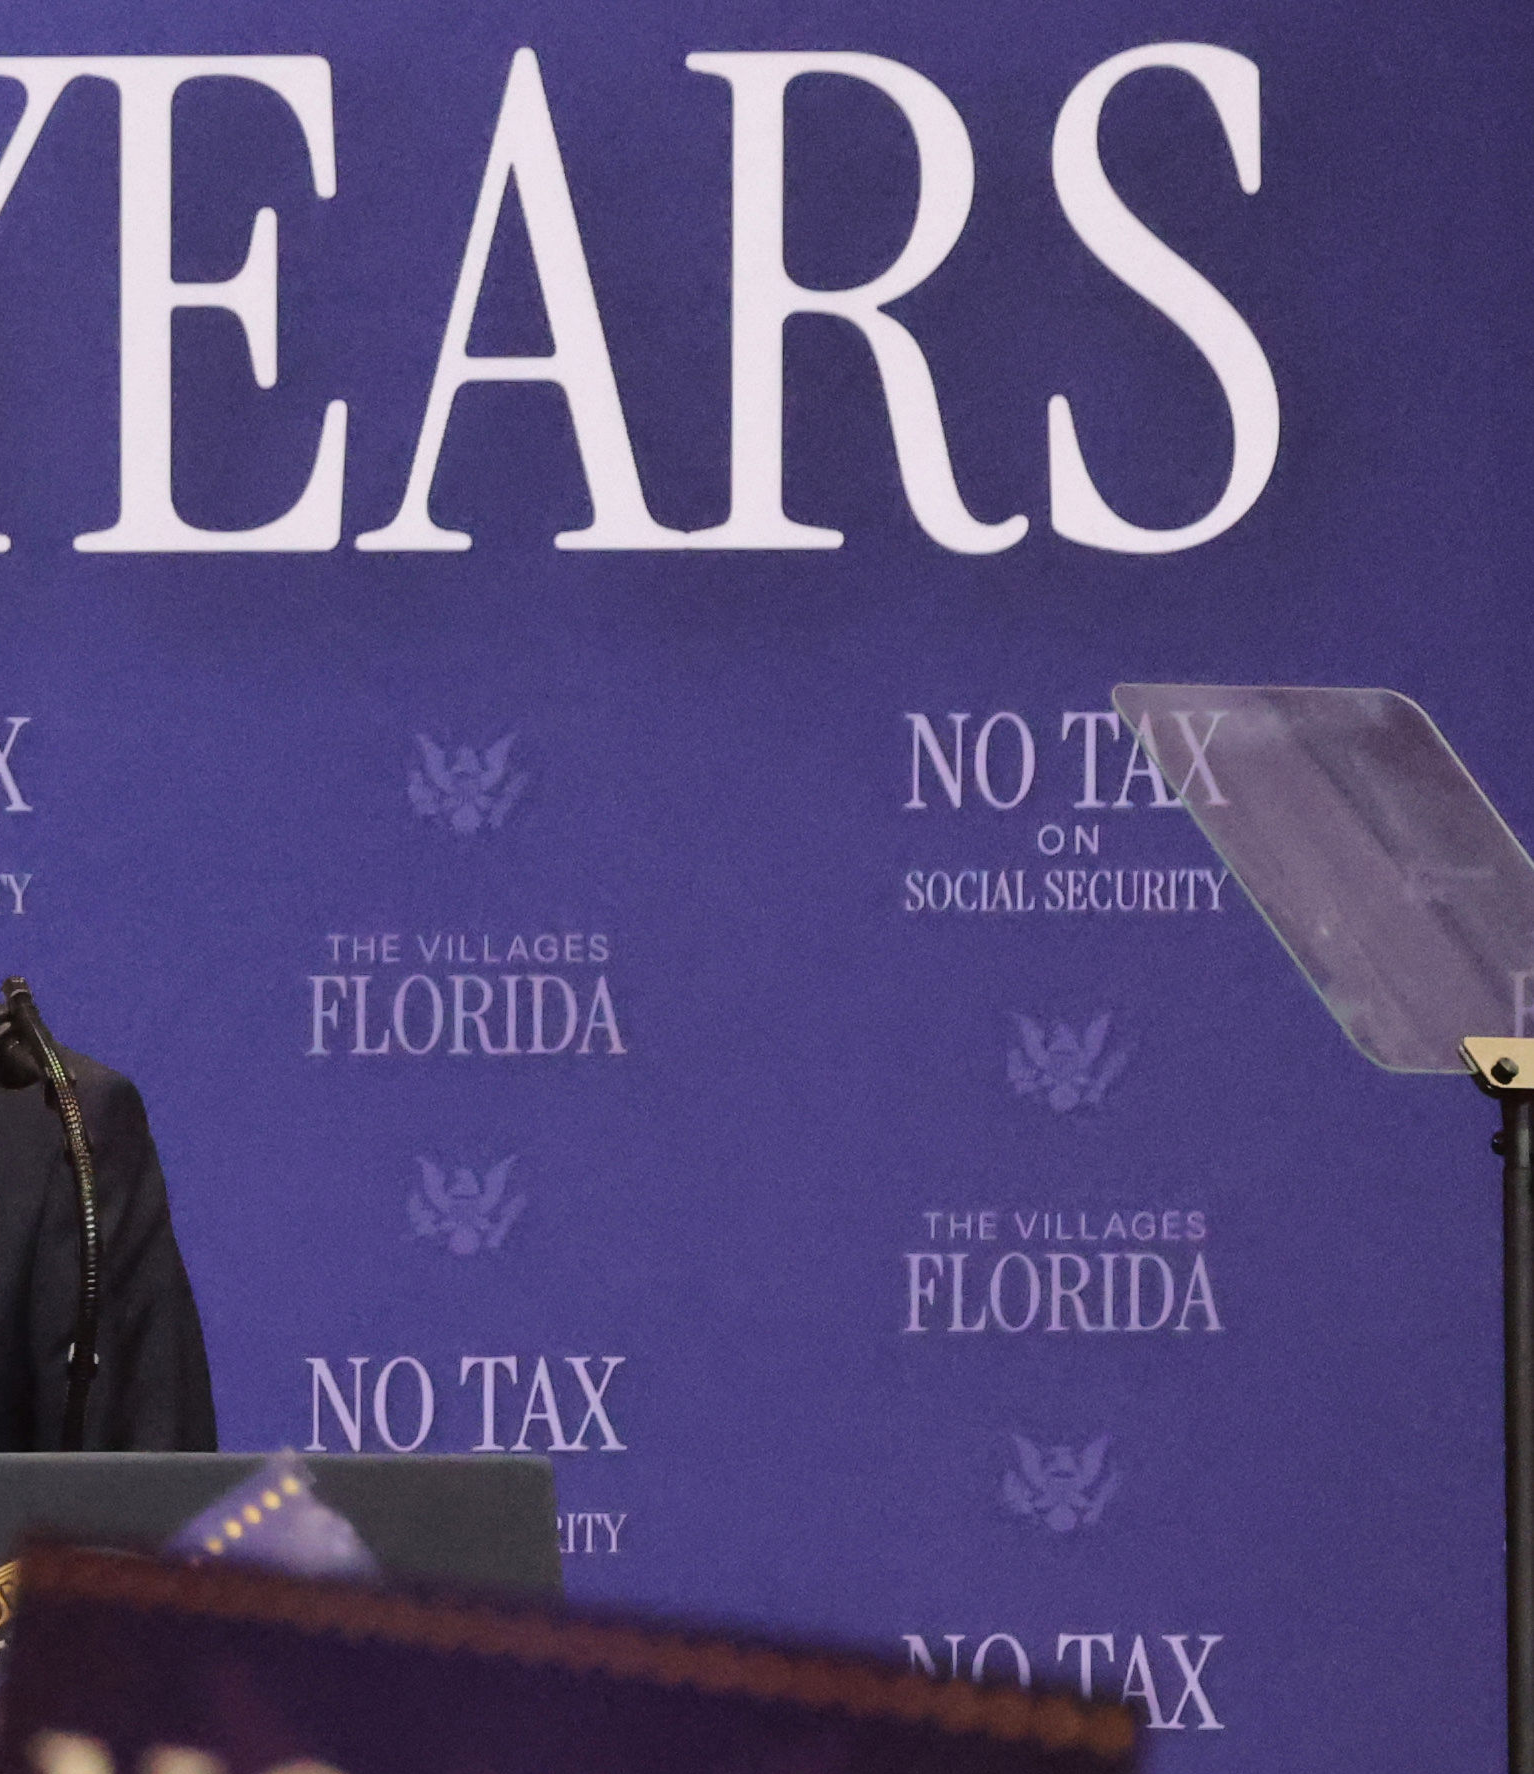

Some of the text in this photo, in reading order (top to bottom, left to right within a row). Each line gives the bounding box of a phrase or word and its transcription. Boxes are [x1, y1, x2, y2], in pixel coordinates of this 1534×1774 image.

[906, 711, 1231, 809] NO TAX
[1037, 824, 1099, 855] ON
[905, 869, 1230, 912] SOCIAL SECURITY
[327, 933, 609, 963] THE VILLAGES
[309, 975, 626, 1054] FLORIDA
[924, 1211, 1206, 1241] THE VILLAGES
[905, 1252, 1221, 1332] FLORIDA
[306, 1356, 626, 1452] NO TAX
[1056, 1633, 1225, 1730] TAX
